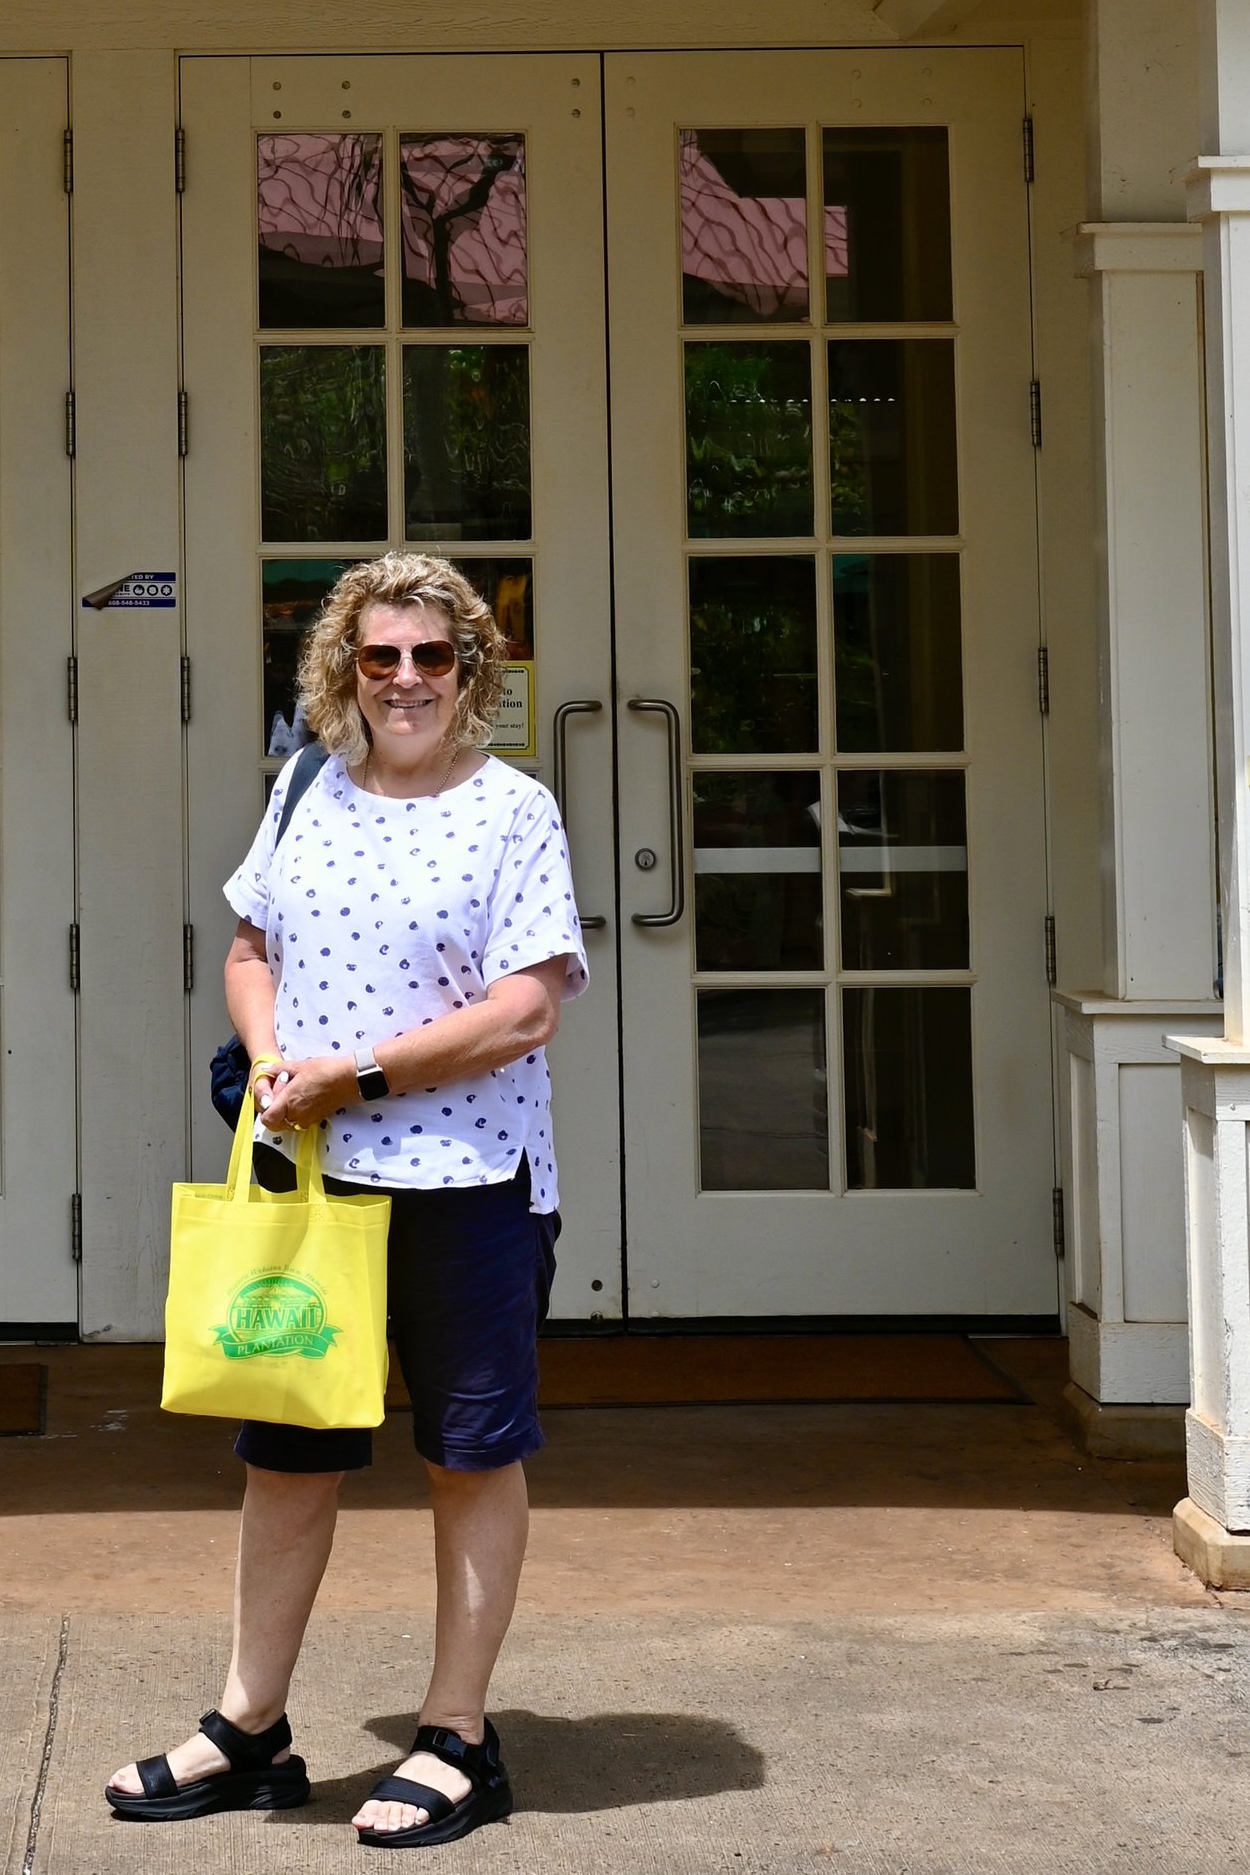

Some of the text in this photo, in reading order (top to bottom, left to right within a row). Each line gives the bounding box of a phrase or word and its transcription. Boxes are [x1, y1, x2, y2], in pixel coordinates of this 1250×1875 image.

[510, 722, 524, 730] stay!
[236, 1306, 318, 1330] HAWAII
[237, 1334, 314, 1356] PLANTATION
